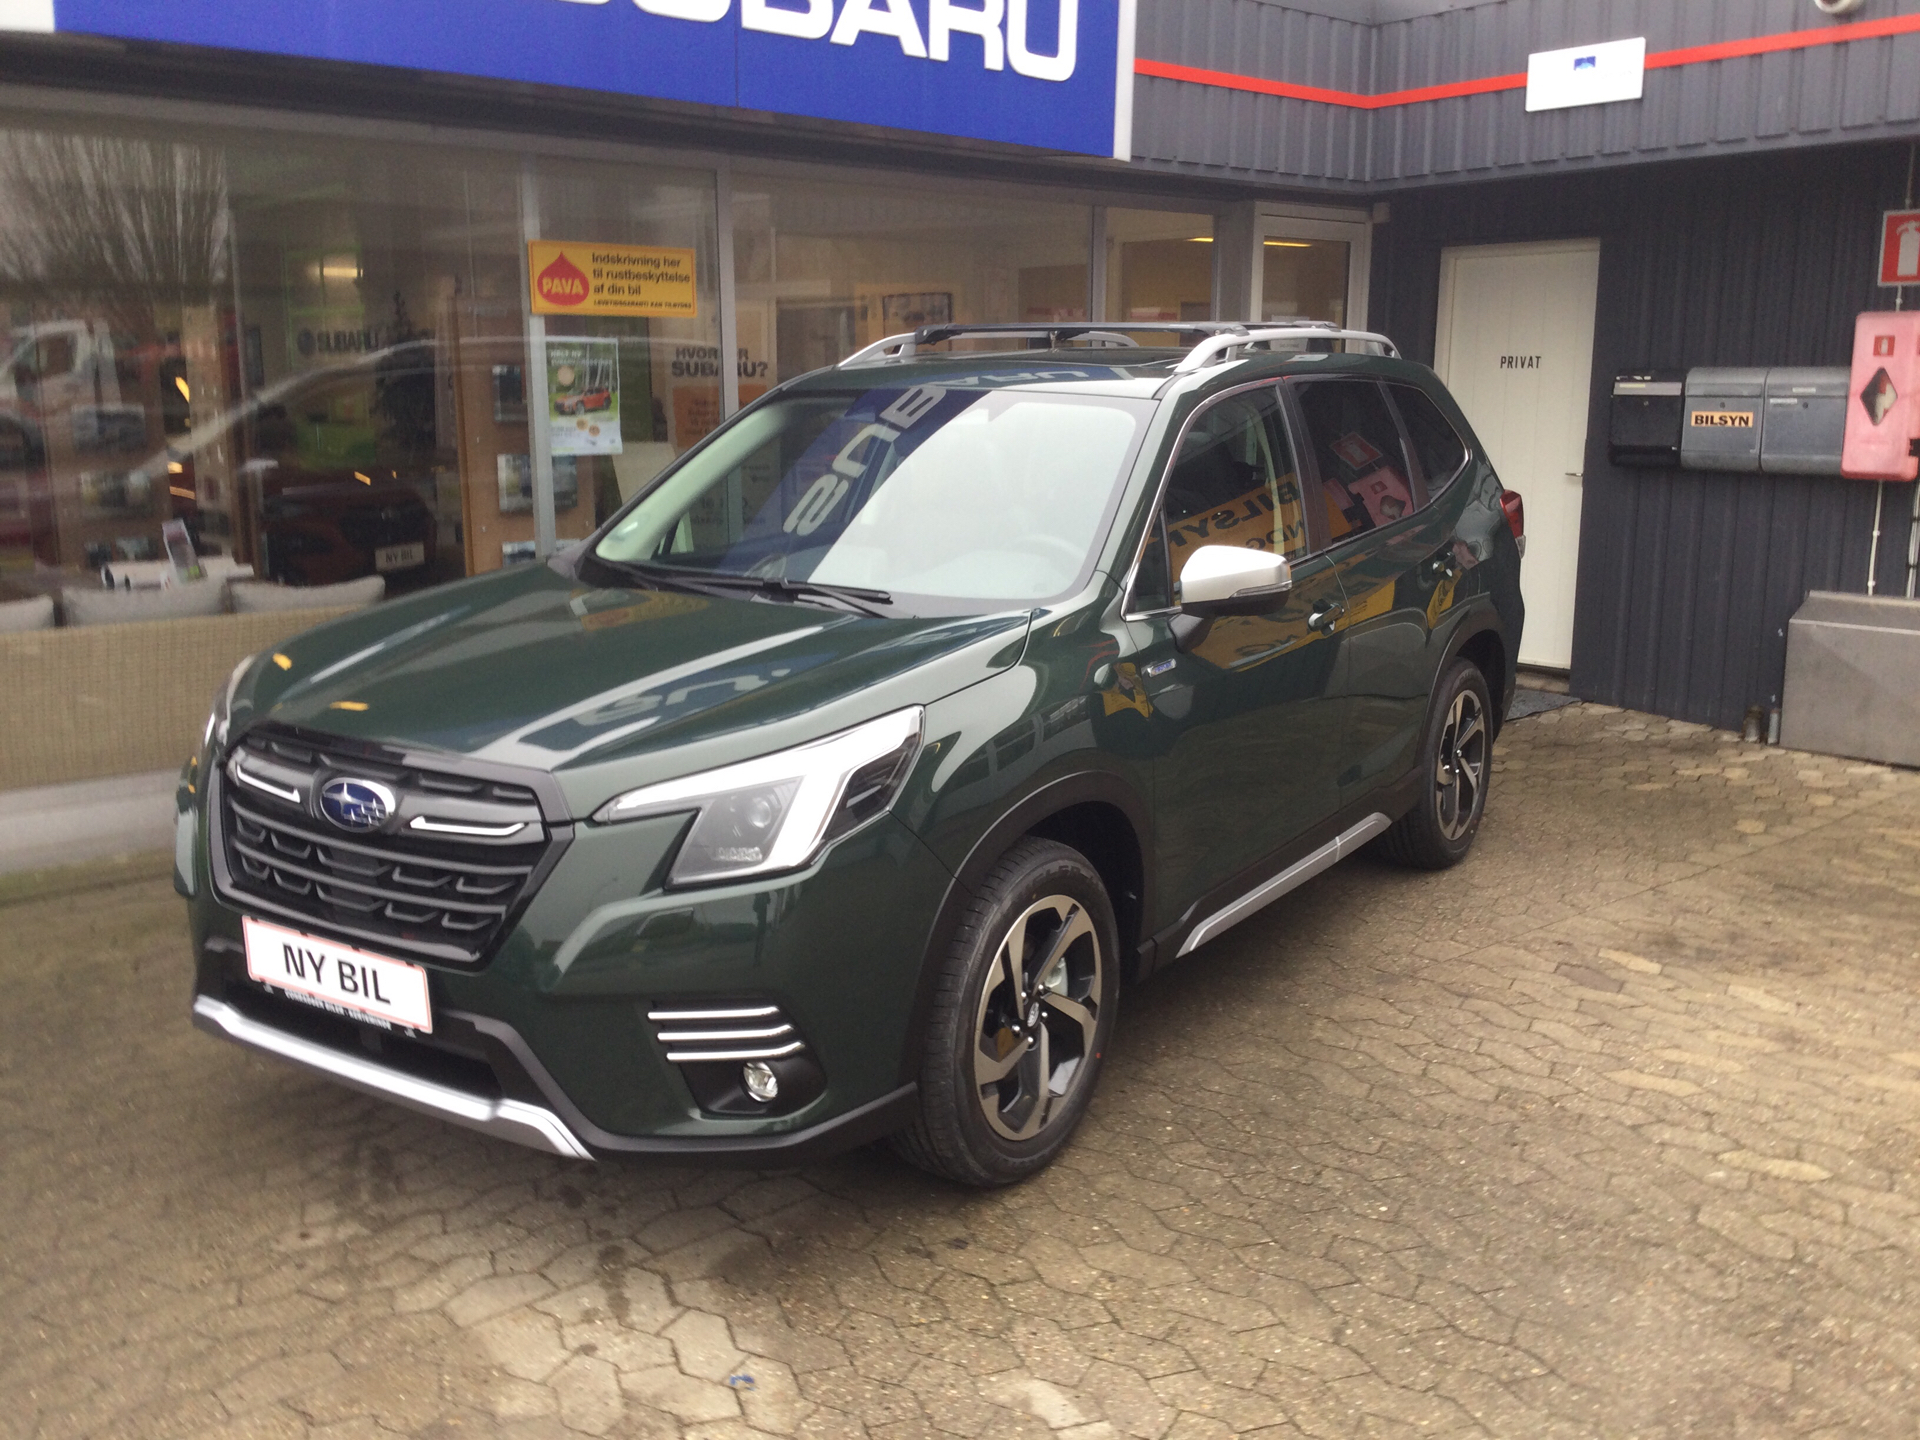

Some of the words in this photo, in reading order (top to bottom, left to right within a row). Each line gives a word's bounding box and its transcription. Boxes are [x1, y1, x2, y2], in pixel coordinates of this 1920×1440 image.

[556, 0, 1078, 82] ARU
[592, 252, 661, 269] Indskrivning
[663, 255, 682, 268] her
[593, 268, 603, 280] til
[606, 269, 691, 284] rustbeskyttelse
[541, 276, 584, 296] PAVA
[593, 283, 605, 295] af
[607, 283, 625, 295] din
[627, 284, 641, 296] bil
[671, 361, 768, 378] SUBU?
[1500, 355, 1541, 369] PRIVAT
[1694, 414, 1750, 427] BILSYN
[282, 942, 326, 985] NY
[337, 958, 392, 1006] BIL
